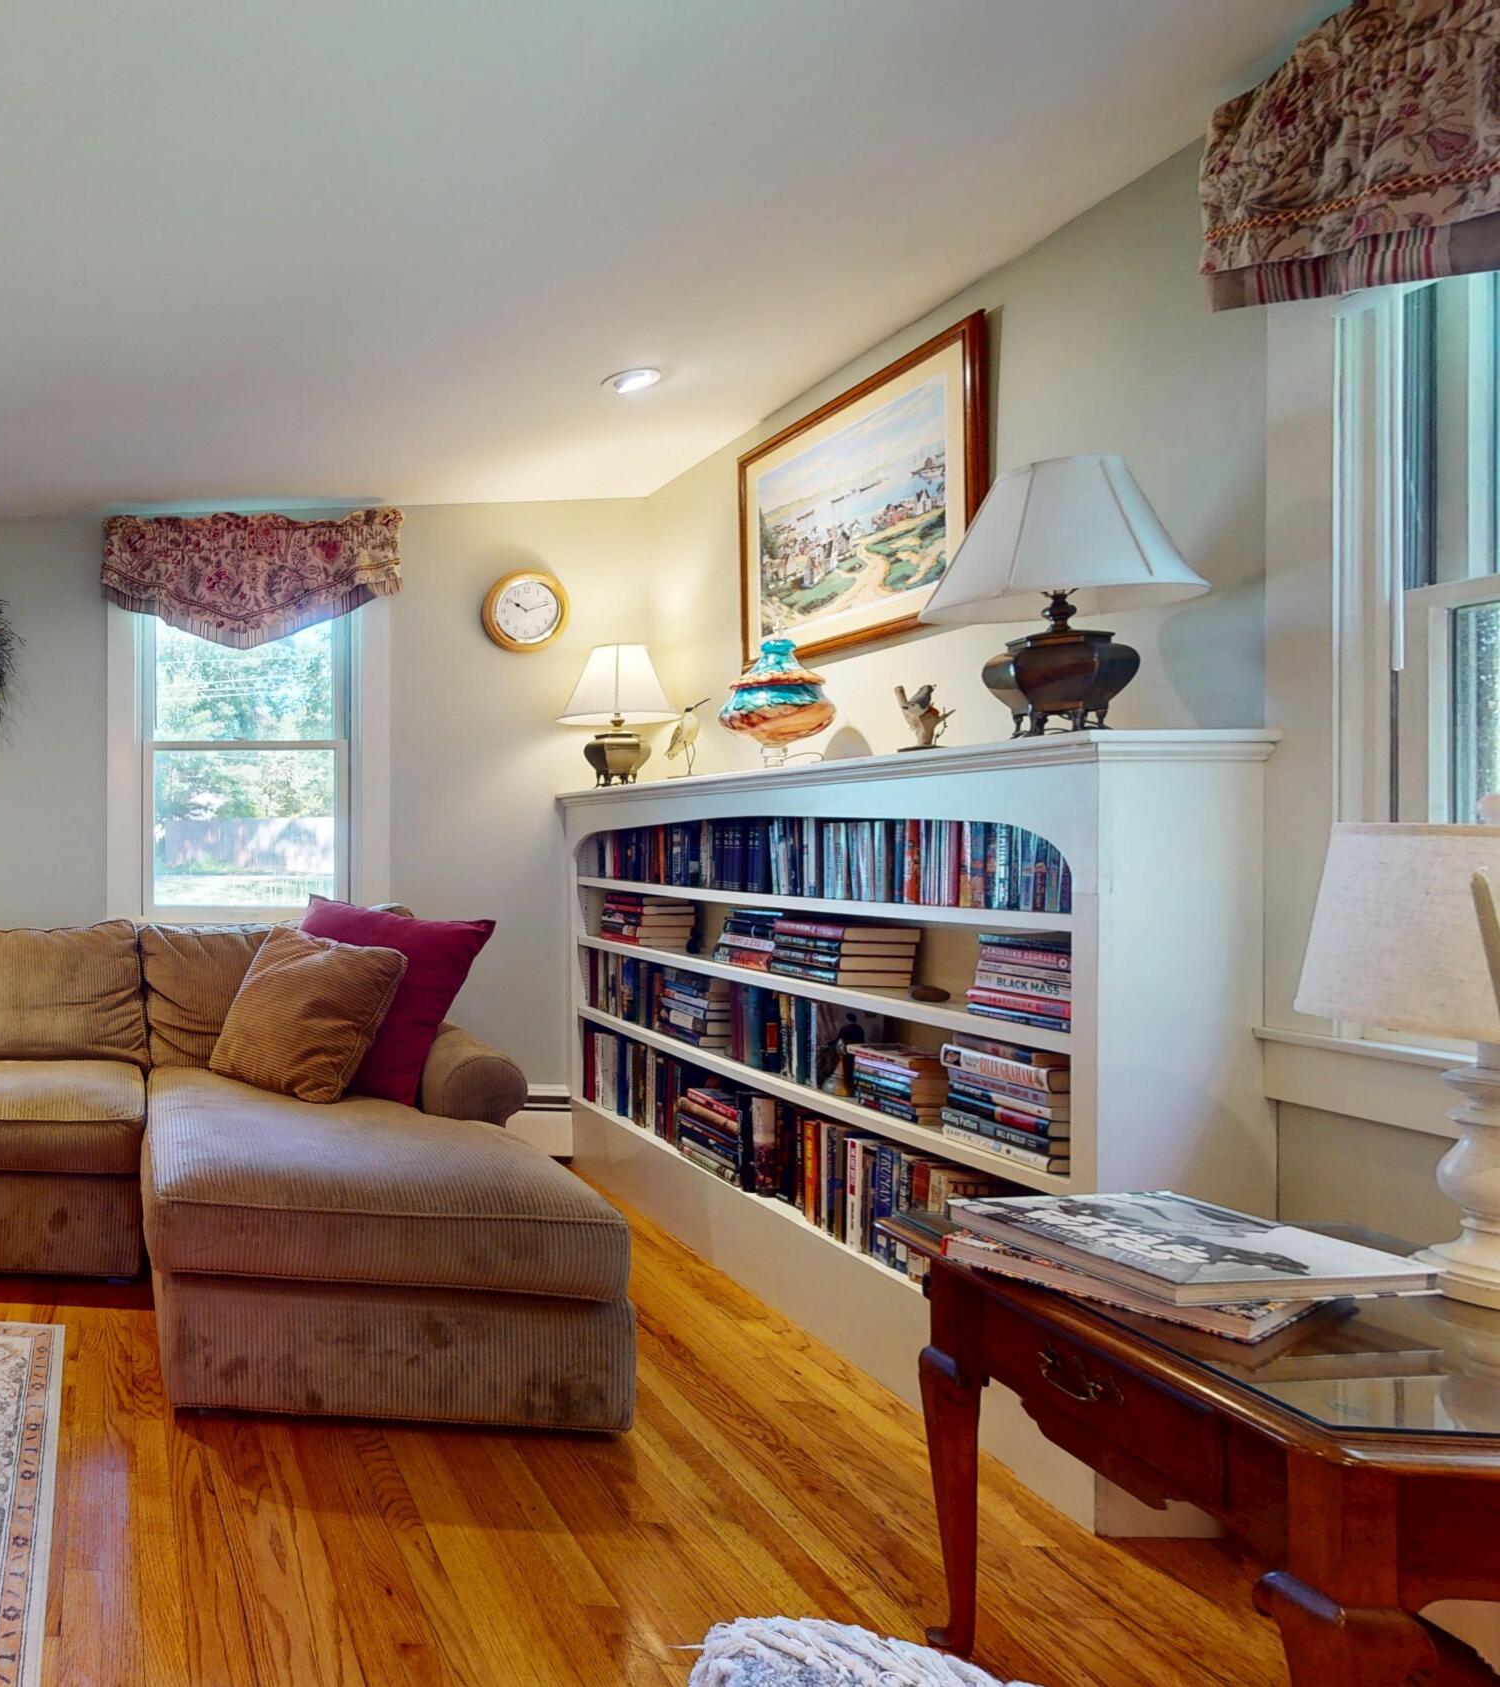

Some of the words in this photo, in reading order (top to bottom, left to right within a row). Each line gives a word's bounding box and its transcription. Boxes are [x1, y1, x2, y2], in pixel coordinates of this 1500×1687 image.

[996, 977, 1028, 991] BLACK
[1031, 982, 1060, 996] MASS
[879, 1151, 891, 1205] TRUMAN
[1024, 1210, 1209, 1263] WARS
